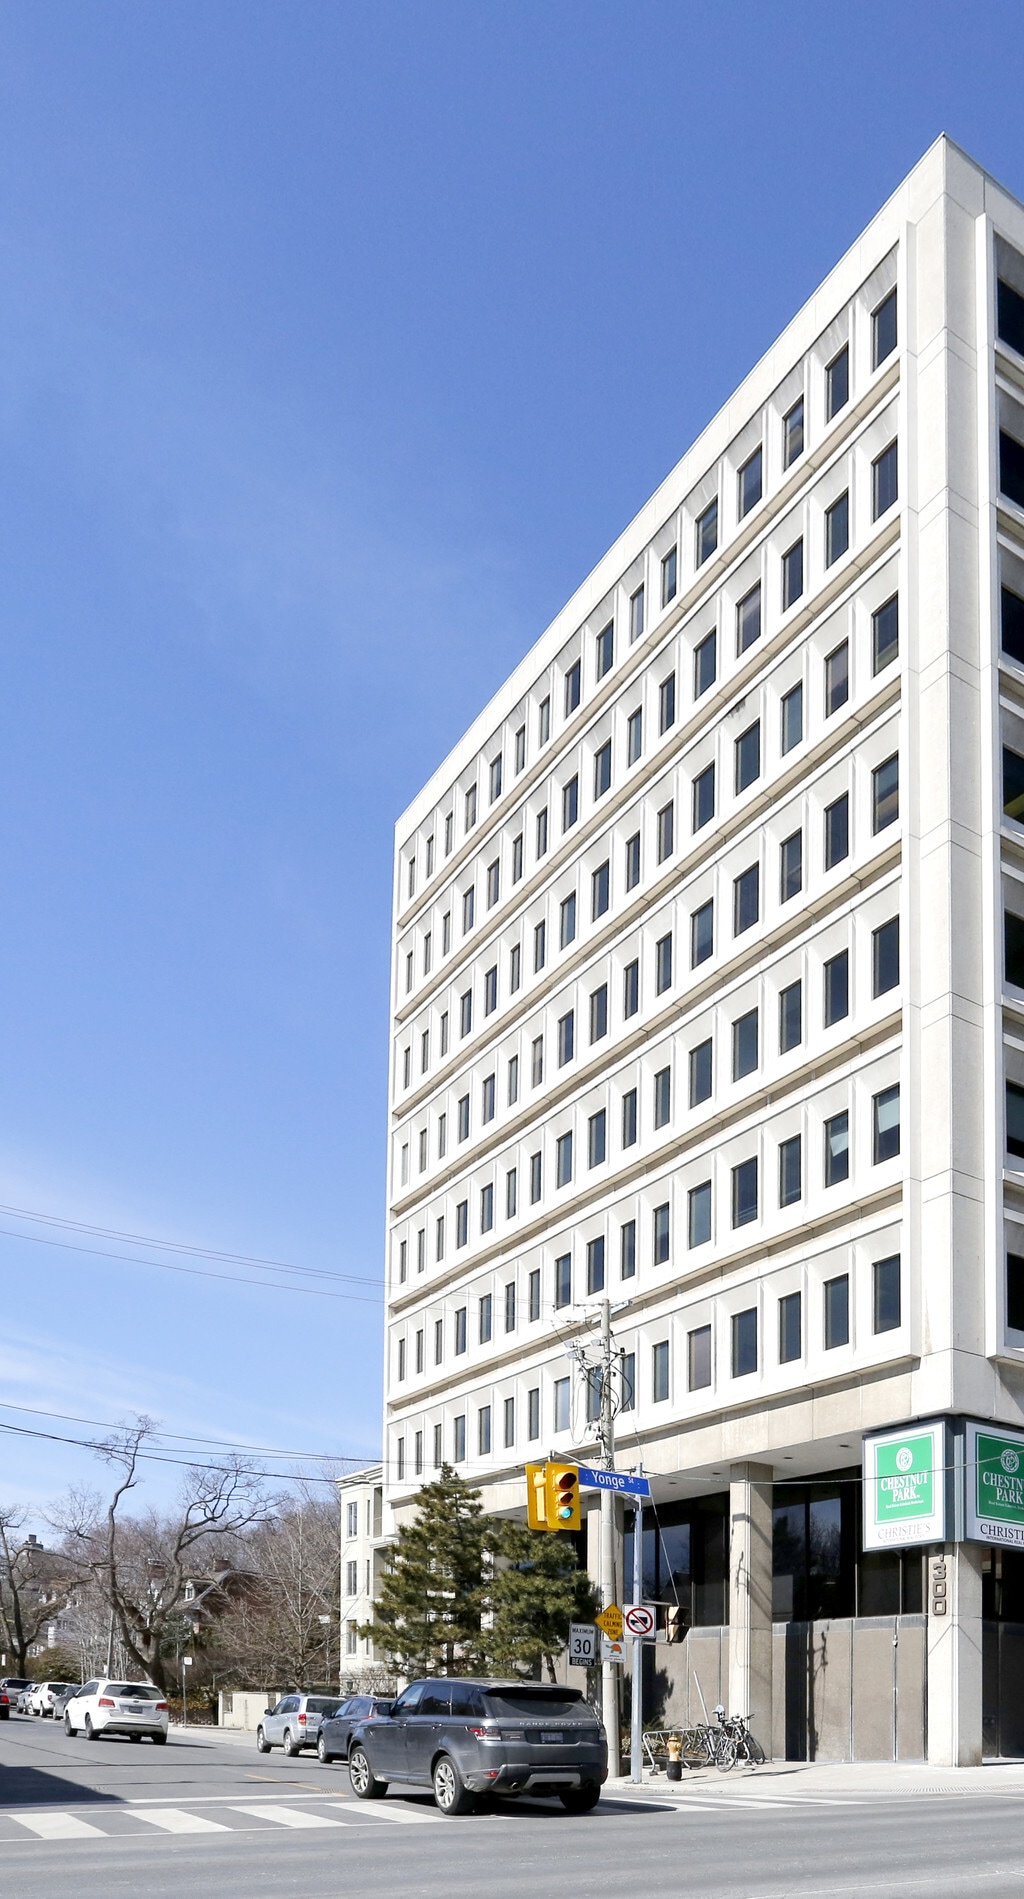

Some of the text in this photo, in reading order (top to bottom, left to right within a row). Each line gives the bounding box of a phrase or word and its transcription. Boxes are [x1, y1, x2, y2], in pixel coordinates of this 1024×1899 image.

[591, 1470, 635, 1490] Yonge St
[880, 1470, 929, 1491] CHESTNUT
[892, 1486, 917, 1503] PARK
[996, 1487, 1024, 1505] PARK
[877, 1522, 931, 1540] CHRISTIE'S
[603, 1620, 622, 1628] CALMING
[604, 1612, 622, 1620] TRAFFIC
[573, 1638, 592, 1655] 30
[571, 1657, 592, 1666] BEGINS
